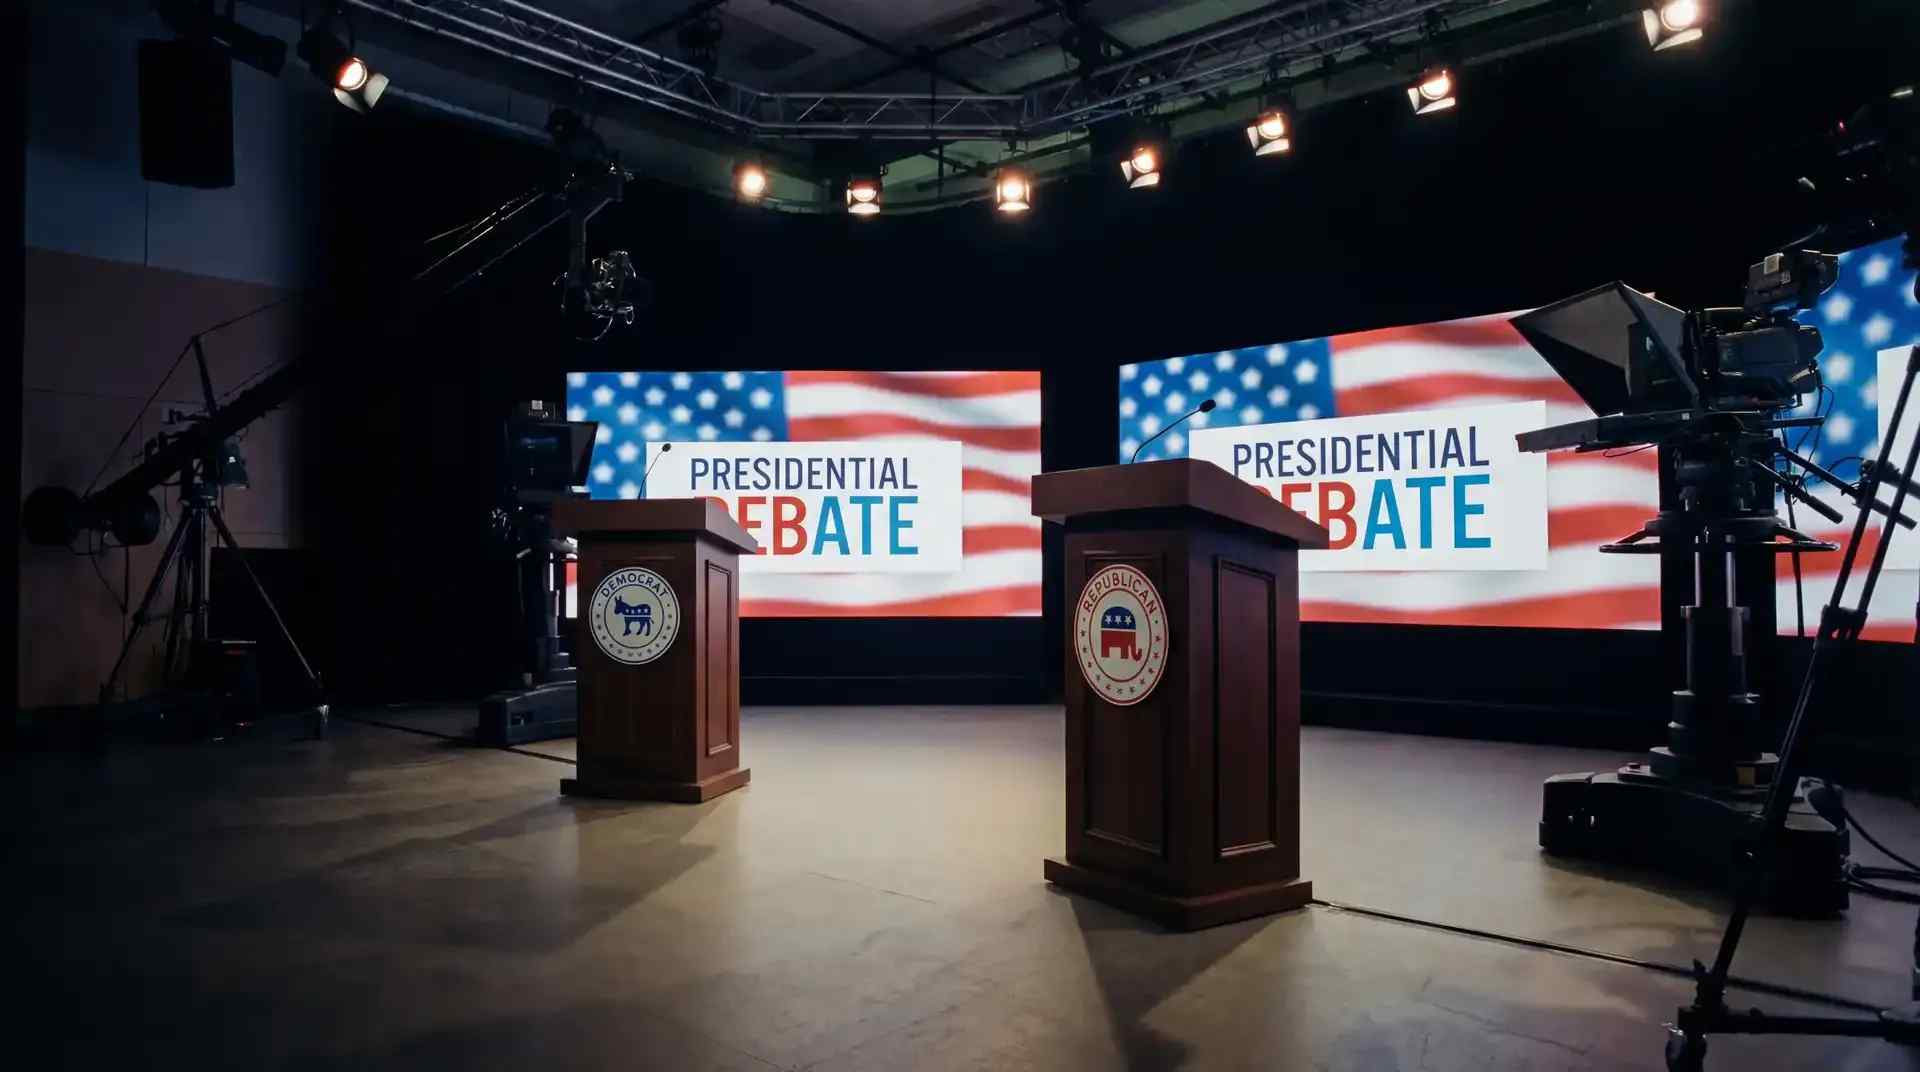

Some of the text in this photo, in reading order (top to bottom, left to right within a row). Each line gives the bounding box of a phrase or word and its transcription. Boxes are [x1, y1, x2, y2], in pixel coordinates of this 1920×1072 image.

[691, 457, 918, 490] PRESIDENTIAL
[1233, 426, 1490, 479] PRESIDENTIAL
[694, 496, 918, 555] EBATE
[601, 573, 669, 598] DEMOCRAT
[1083, 572, 1157, 614] REPUBLICAN
